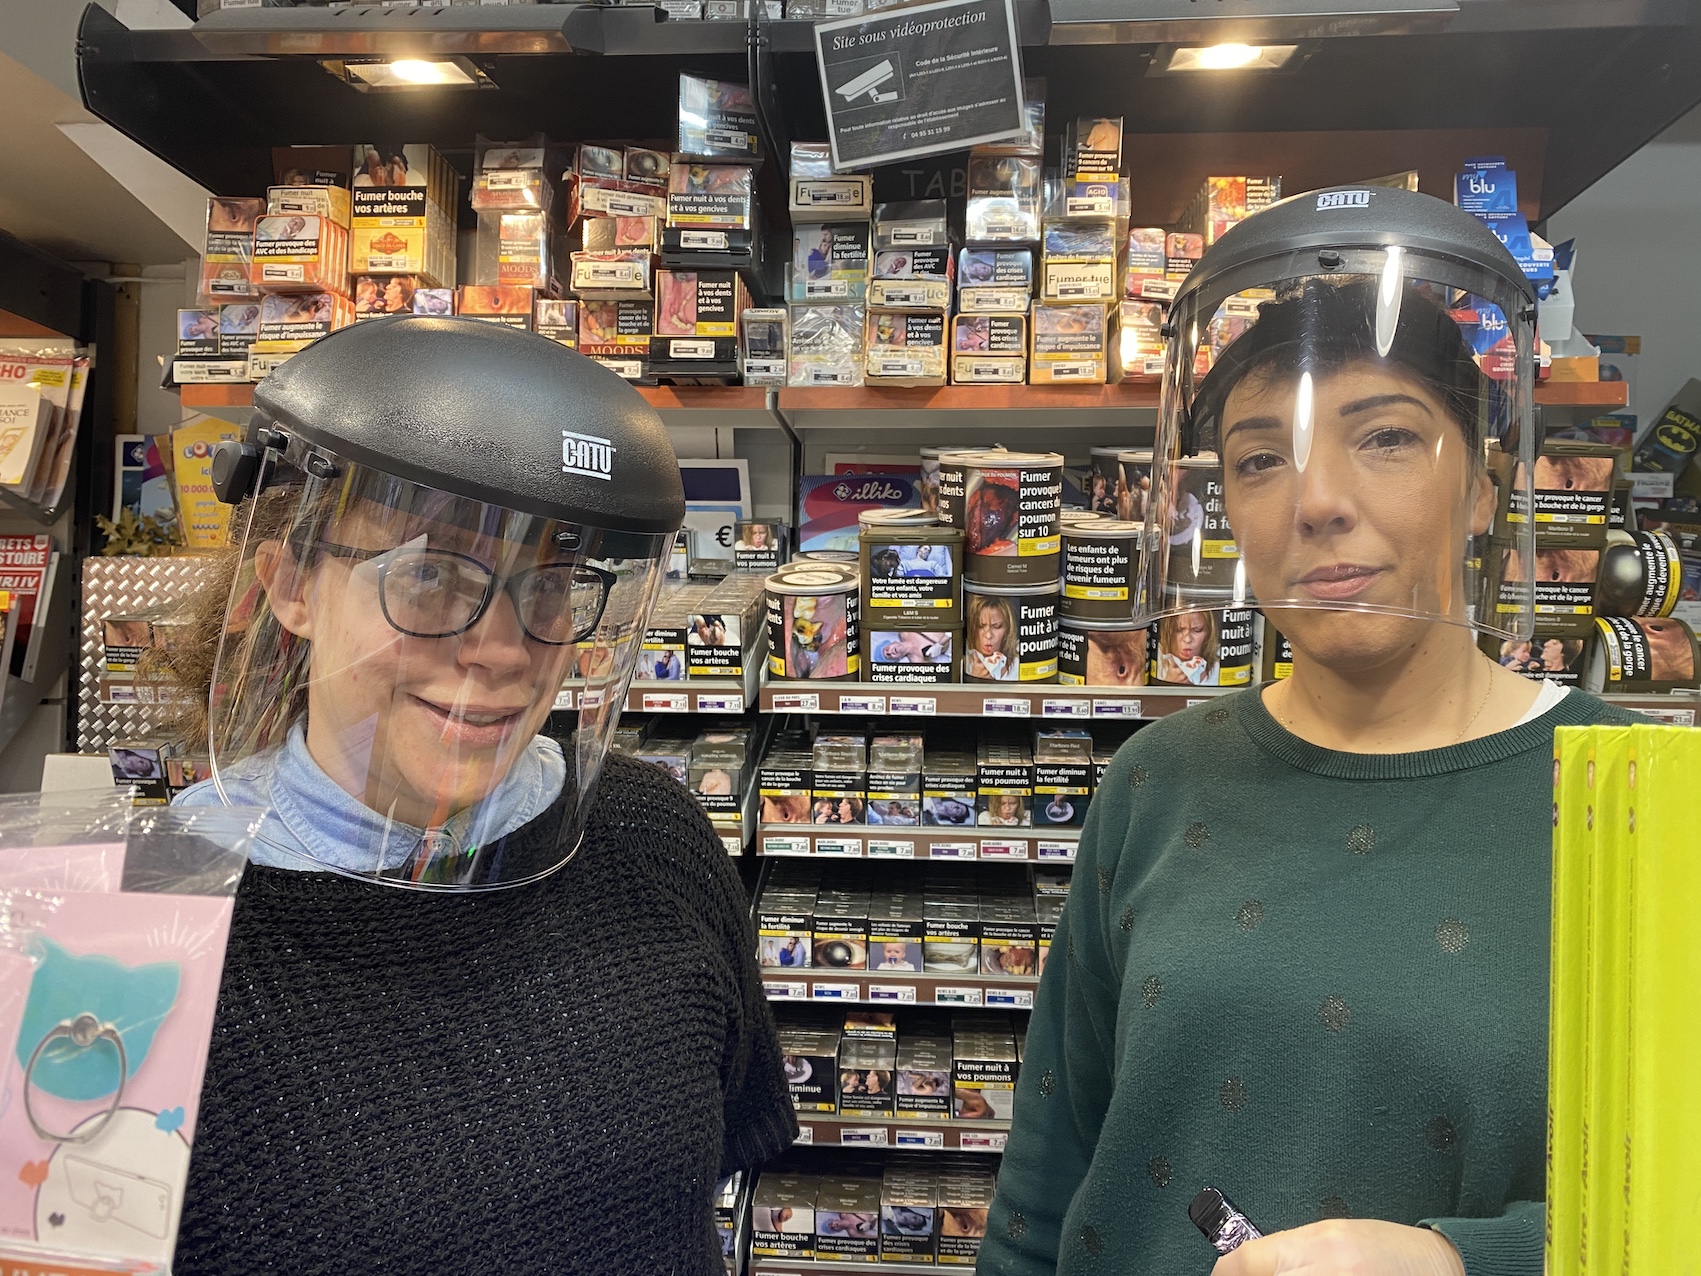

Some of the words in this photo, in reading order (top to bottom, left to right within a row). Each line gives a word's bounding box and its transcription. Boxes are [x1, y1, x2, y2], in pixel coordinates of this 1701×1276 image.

[832, 36, 856, 50] Site
[859, 31, 886, 44] sous
[891, 10, 986, 38] vidéoprotection
[946, 51, 970, 61] Sécurité
[971, 47, 998, 56] Intérieure
[865, 120, 891, 128] information
[1462, 174, 1480, 183] my
[1470, 179, 1495, 193] blu
[355, 192, 386, 201] Fumer
[388, 190, 424, 201] bouche
[1317, 191, 1370, 207] CATU
[354, 205, 371, 214] vos
[372, 203, 408, 214] artères
[288, 248, 317, 256] handicaps
[841, 250, 866, 259] fertilité
[1482, 313, 1504, 330] blu
[591, 346, 643, 354] MOODS
[1666, 410, 1701, 434] BATMA
[563, 438, 612, 473] CATU
[946, 471, 963, 483] nuit
[1020, 471, 1051, 483] Fumer
[851, 481, 903, 500] illiko
[943, 486, 964, 496] dents
[1020, 486, 1058, 499] provoque
[1020, 500, 1054, 510] cancers
[1054, 498, 1061, 508] du
[1587, 504, 1605, 512] gorge
[1020, 514, 1056, 526] poumon
[715, 525, 732, 548] €
[1019, 528, 1036, 538] sur
[1038, 526, 1049, 536] 10
[1067, 544, 1077, 552] Les
[1078, 544, 1106, 554] enfants
[1108, 545, 1119, 554] de
[1642, 543, 1650, 552] le
[1067, 553, 1095, 563] fumeurs
[1096, 556, 1111, 564] ont
[1112, 555, 1128, 566] plus
[1067, 563, 1075, 572] de
[1076, 565, 1102, 574] risques
[1104, 565, 1114, 574] de
[1656, 551, 1667, 583] devenir
[1067, 573, 1092, 582] devenir
[1093, 574, 1126, 583] fumeurs
[1646, 552, 1657, 595] augmente
[1657, 586, 1665, 596] de
[1020, 605, 1055, 619] Fumer
[1020, 622, 1044, 636] nuit
[1046, 620, 1052, 632] à
[1620, 632, 1629, 641] de
[1632, 634, 1641, 642] le
[1624, 641, 1631, 650] la
[1623, 651, 1633, 676] gorge
[1636, 645, 1646, 671] cancer
[872, 664, 896, 672] Fumer
[898, 665, 932, 674] provoque
[934, 664, 950, 673] des
[895, 674, 936, 683] cardiaques
[1005, 768, 1020, 776] nuit
[995, 777, 1029, 786] poumons
[1044, 775, 1069, 783] fertilité
[957, 1062, 984, 1072] Fumer
[985, 1063, 1002, 1072] nuit
[1003, 1063, 1010, 1072] à
[973, 1073, 1011, 1082] poumons
[755, 1232, 778, 1241] Fumer
[780, 1232, 808, 1242] bouche
[772, 1240, 796, 1250] artères
